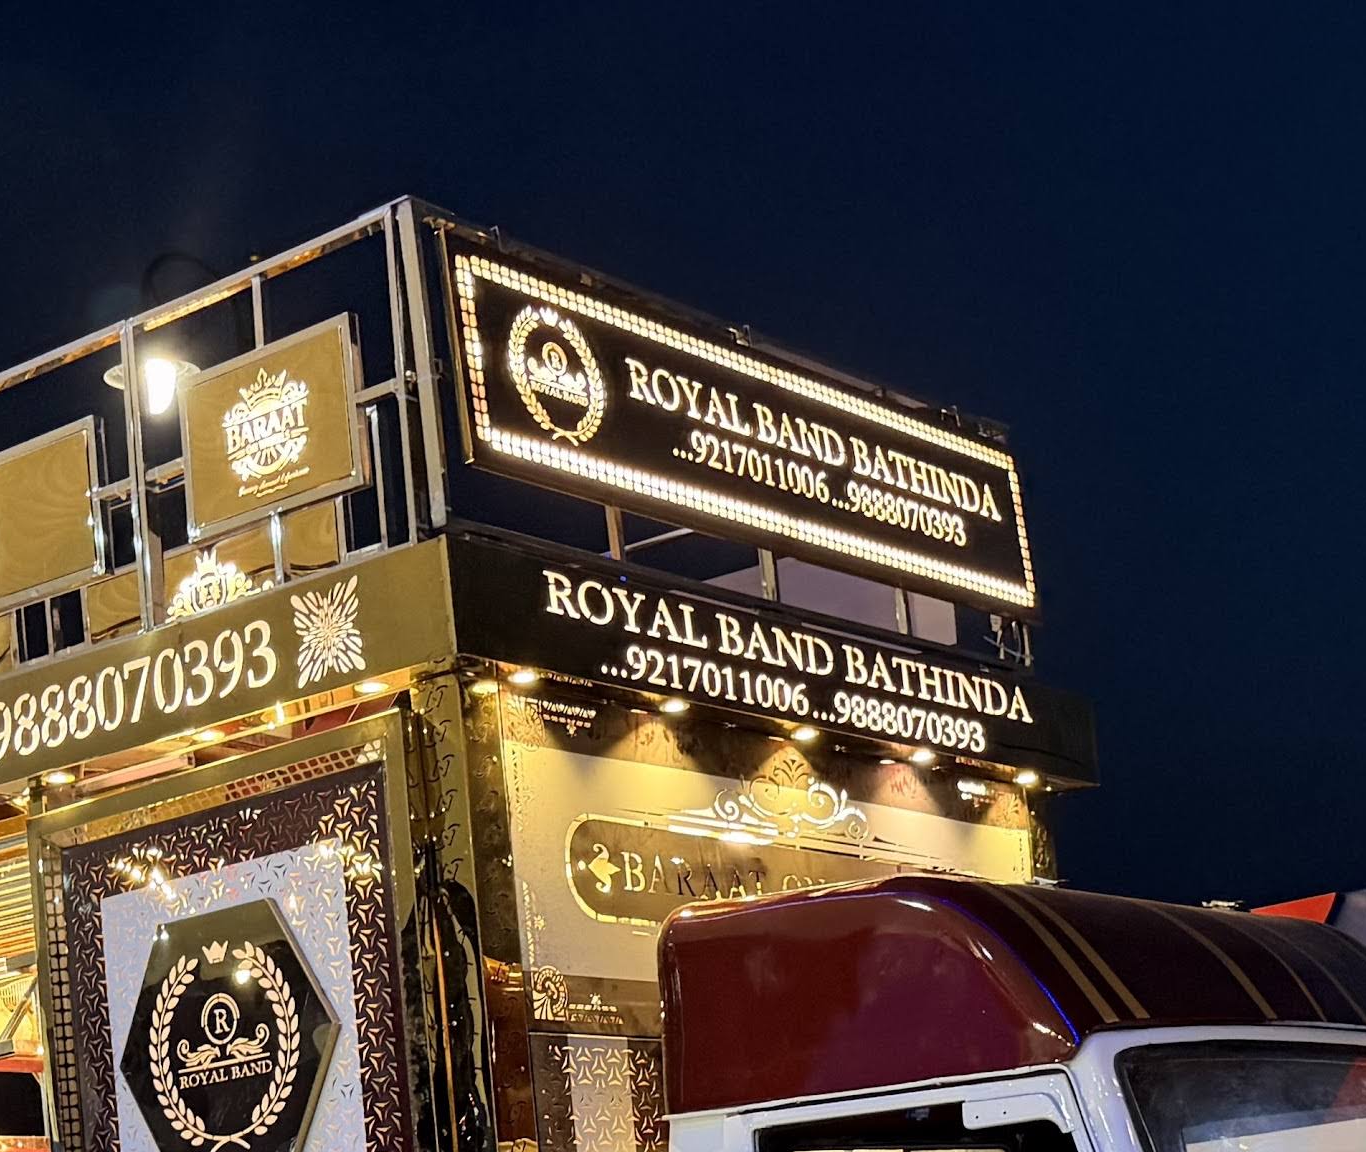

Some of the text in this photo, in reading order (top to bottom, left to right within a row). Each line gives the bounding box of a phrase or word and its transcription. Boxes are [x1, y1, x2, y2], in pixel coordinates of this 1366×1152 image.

[226, 397, 308, 454] BARAAT
[624, 357, 1002, 521] ROYAL BAND BATHINDA
[542, 570, 1034, 724] ROYAL BAND BATHINDA
[621, 851, 766, 900] BARAAT
[213, 1008, 230, 1034] R
[179, 1060, 273, 1090] ROYAL BAND
